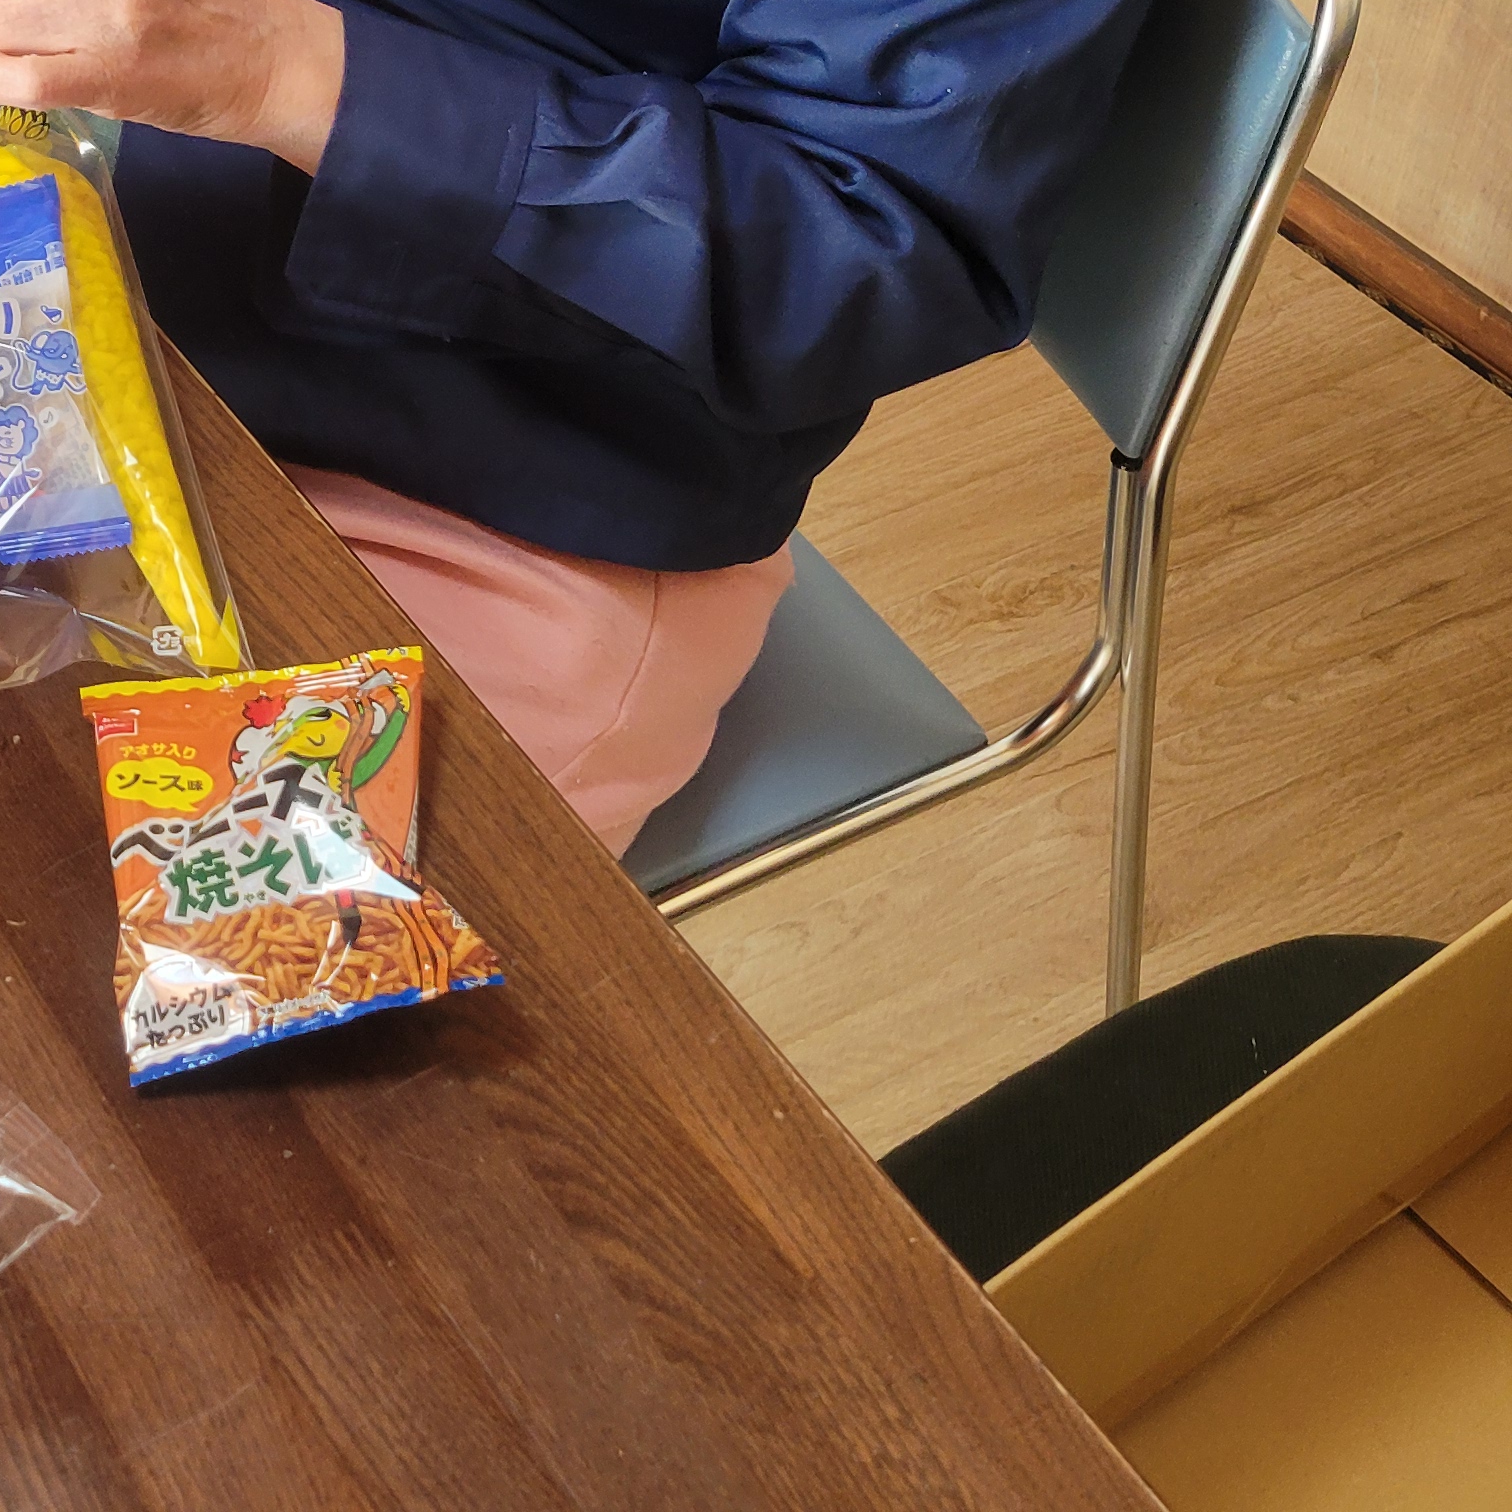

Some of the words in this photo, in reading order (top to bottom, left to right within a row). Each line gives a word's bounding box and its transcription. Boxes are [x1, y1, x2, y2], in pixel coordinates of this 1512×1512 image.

[120, 742, 197, 760] アオサ入り
[115, 773, 204, 792] ソース味
